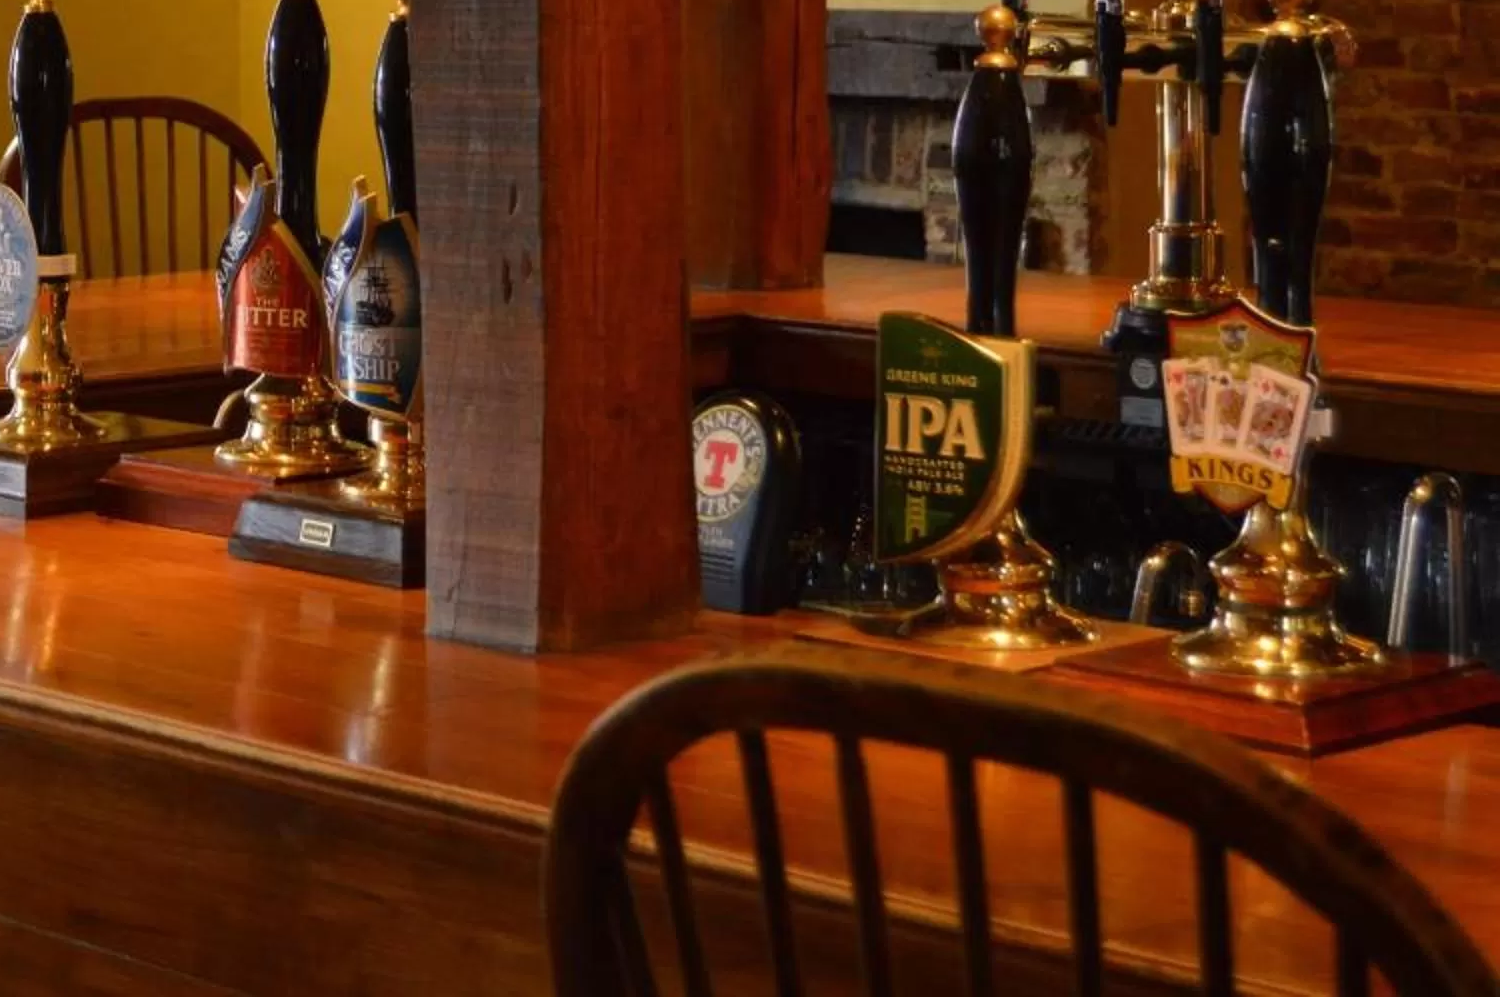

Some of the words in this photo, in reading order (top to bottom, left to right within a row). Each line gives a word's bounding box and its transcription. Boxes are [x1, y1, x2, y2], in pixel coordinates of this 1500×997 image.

[256, 296, 280, 307] THE
[239, 306, 309, 329] ITTER
[338, 329, 398, 357] GHOST
[353, 357, 400, 383] SHIP
[885, 368, 937, 385] GREENE
[941, 374, 978, 388] KING
[883, 391, 986, 460] IPA
[703, 441, 738, 489] T
[1187, 456, 1273, 491] KINGS
